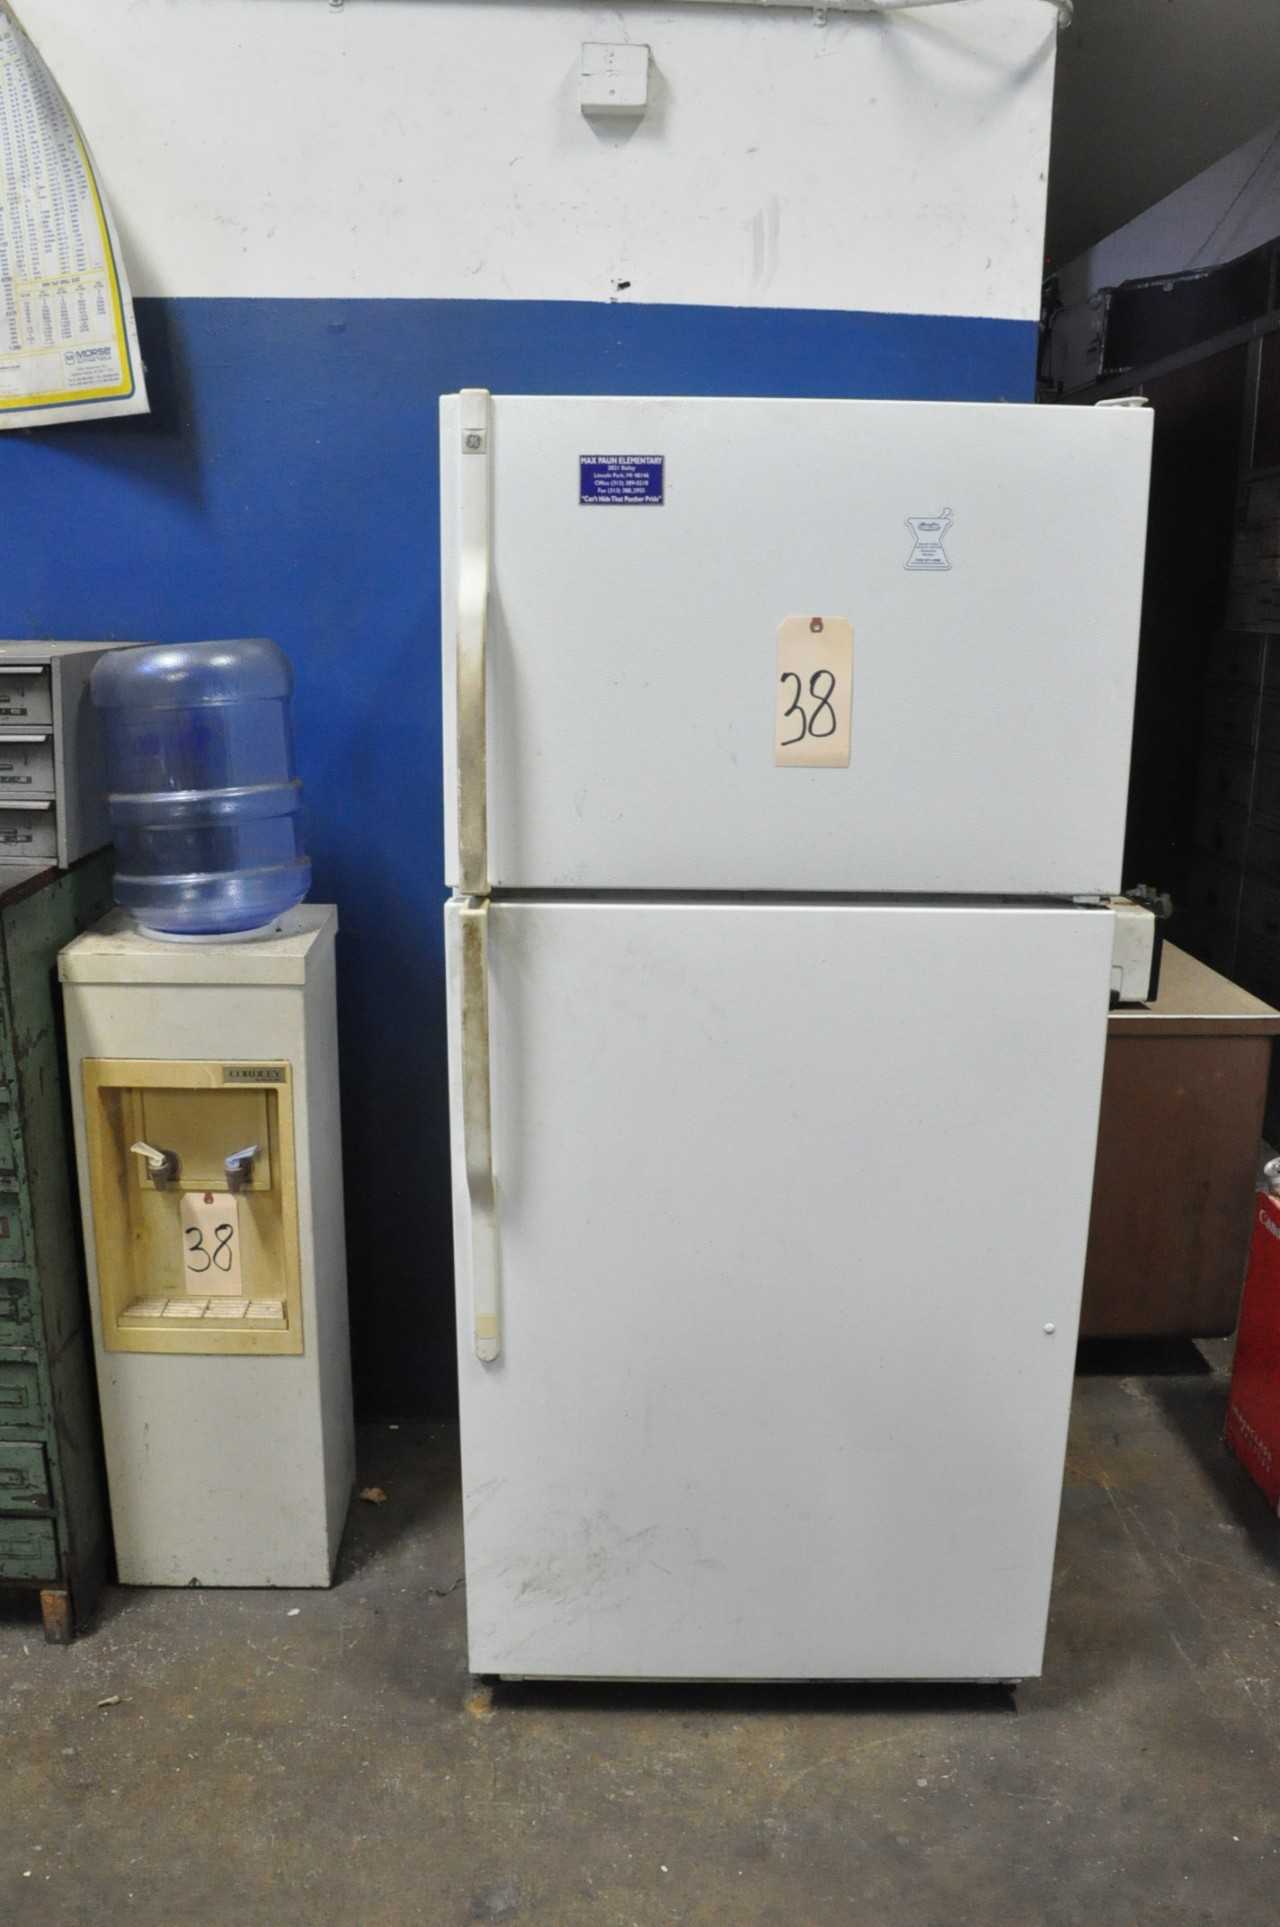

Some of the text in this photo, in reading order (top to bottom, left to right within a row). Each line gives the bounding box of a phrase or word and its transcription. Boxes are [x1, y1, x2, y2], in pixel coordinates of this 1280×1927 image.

[76, 347, 111, 359] MORSE
[780, 669, 837, 746] 38
[185, 1224, 234, 1272] 38
